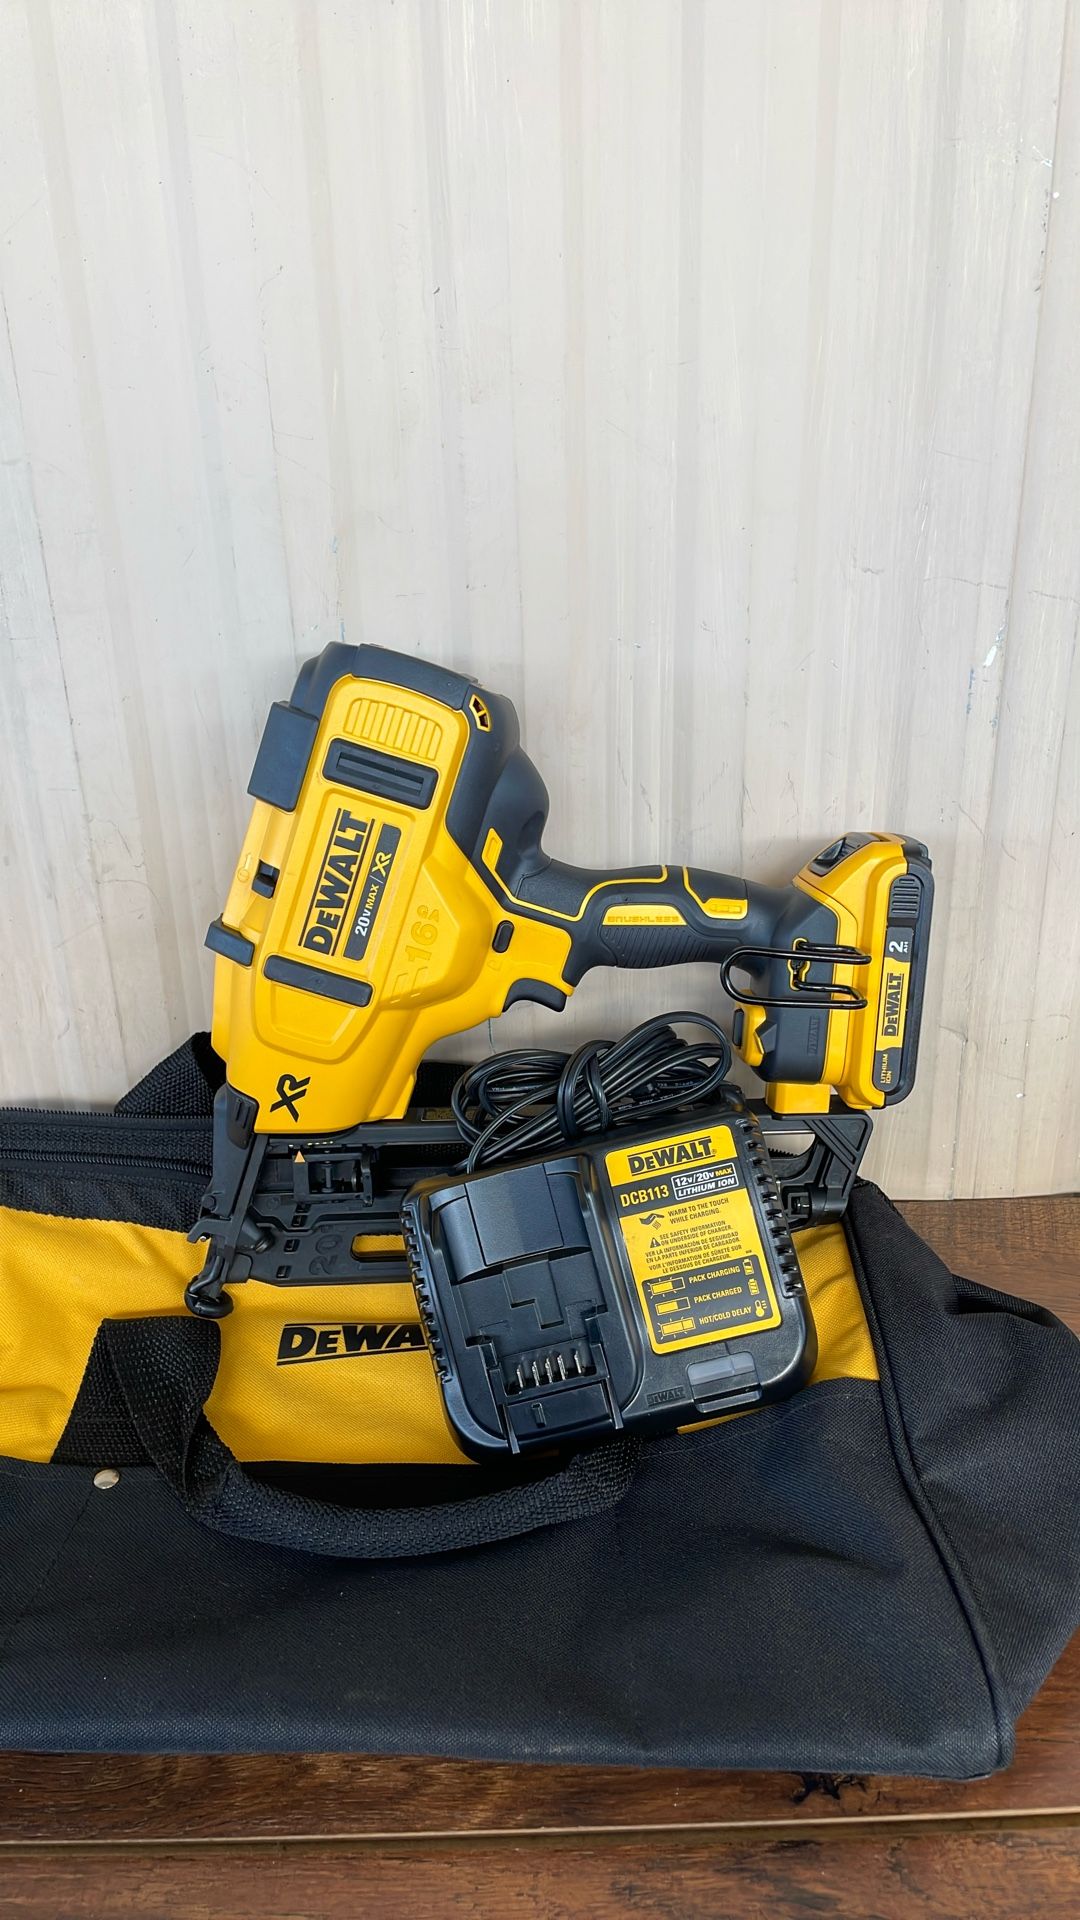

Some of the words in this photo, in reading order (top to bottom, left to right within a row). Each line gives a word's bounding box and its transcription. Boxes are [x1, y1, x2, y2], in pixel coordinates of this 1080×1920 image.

[371, 850, 392, 878] XR
[303, 809, 368, 955] DEWALT
[365, 883, 379, 911] MAX
[405, 922, 438, 962] 16
[888, 941, 904, 953] 2
[883, 973, 903, 1037] DEWALT
[880, 1054, 889, 1084] LITHIUM
[270, 1073, 311, 1122] XR
[628, 1138, 715, 1174] DEWALT
[715, 1168, 733, 1177] MAX
[620, 1185, 670, 1208] DCB113
[678, 1183, 716, 1197] LITHIUM
[717, 1178, 735, 1187] ION
[668, 1208, 687, 1217] WARM
[710, 1198, 729, 1207] TOUCH
[670, 1216, 689, 1224] WHILE
[670, 1229, 689, 1238] SAFETY
[690, 1221, 726, 1233] INFORMATION
[670, 1233, 699, 1244] UNDERSIDE
[709, 1232, 739, 1242] SEGURIDAD
[662, 1251, 678, 1260] PARTE
[679, 1246, 703, 1256] INFERIOR
[662, 1254, 702, 1268] L'INFORMATION
[669, 1262, 694, 1272] DESSOUS
[689, 1275, 705, 1283] PACK
[706, 1266, 741, 1279] CHARGING
[694, 1295, 711, 1303] PACK
[712, 1287, 742, 1299] CHARGED
[699, 1312, 731, 1325] HOT/COLD
[732, 1306, 752, 1317] DELAY
[278, 1324, 428, 1361] DEWA
